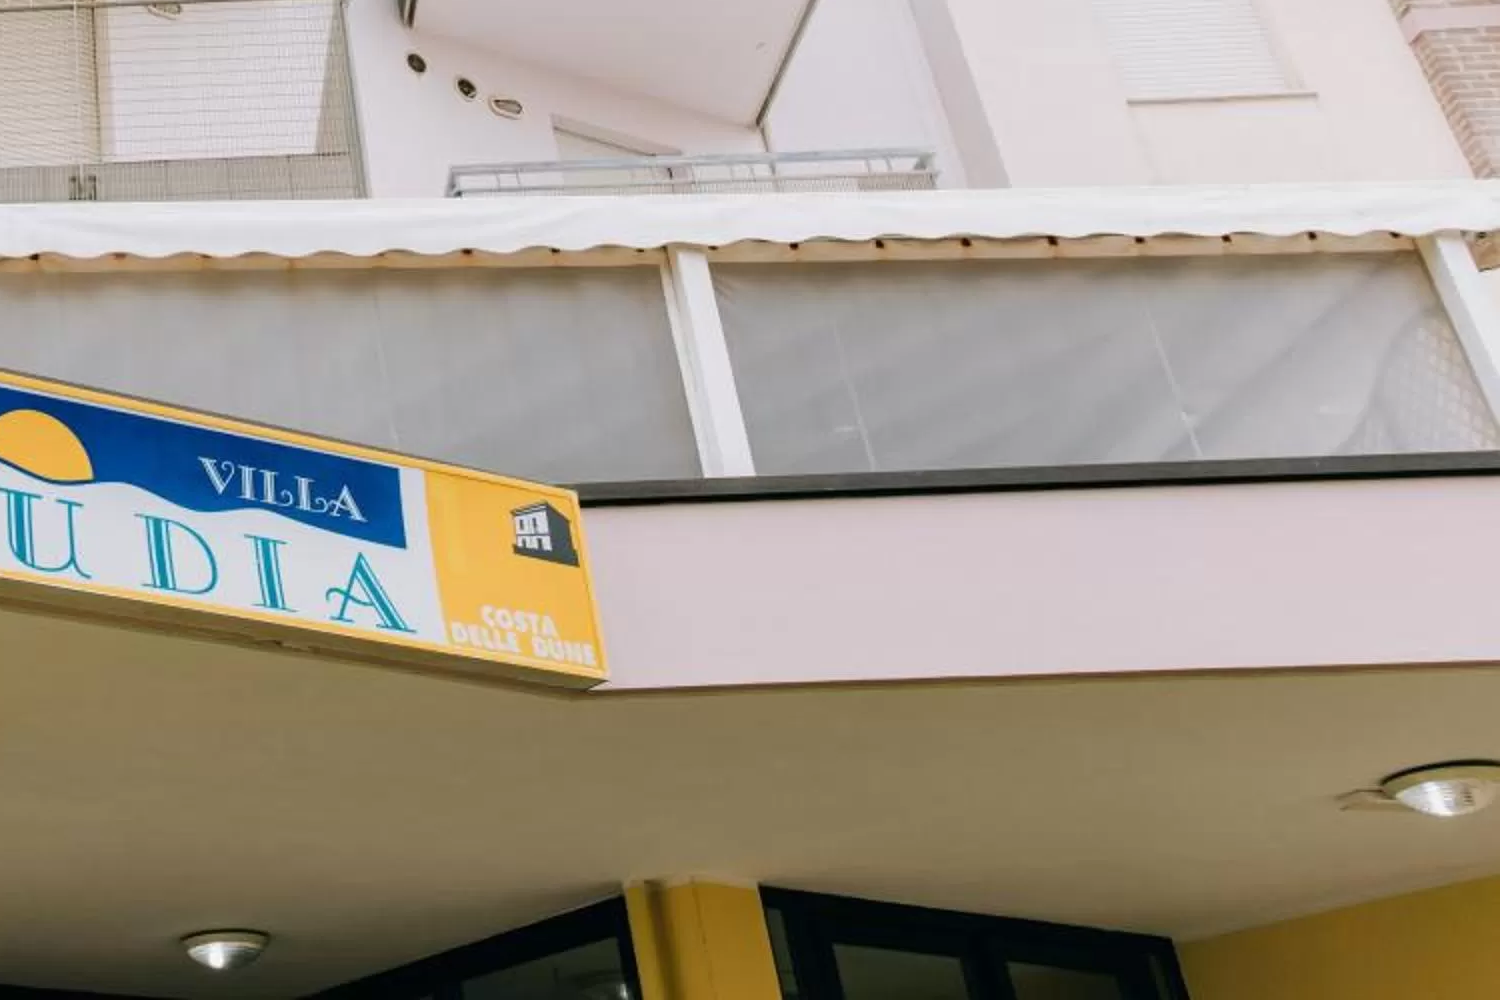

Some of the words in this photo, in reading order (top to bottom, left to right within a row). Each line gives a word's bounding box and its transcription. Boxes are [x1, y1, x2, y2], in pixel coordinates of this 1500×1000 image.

[197, 456, 368, 522] VILLA
[450, 621, 522, 653] DELLE
[531, 635, 597, 666] DUNE
[480, 604, 560, 638] COSTA
